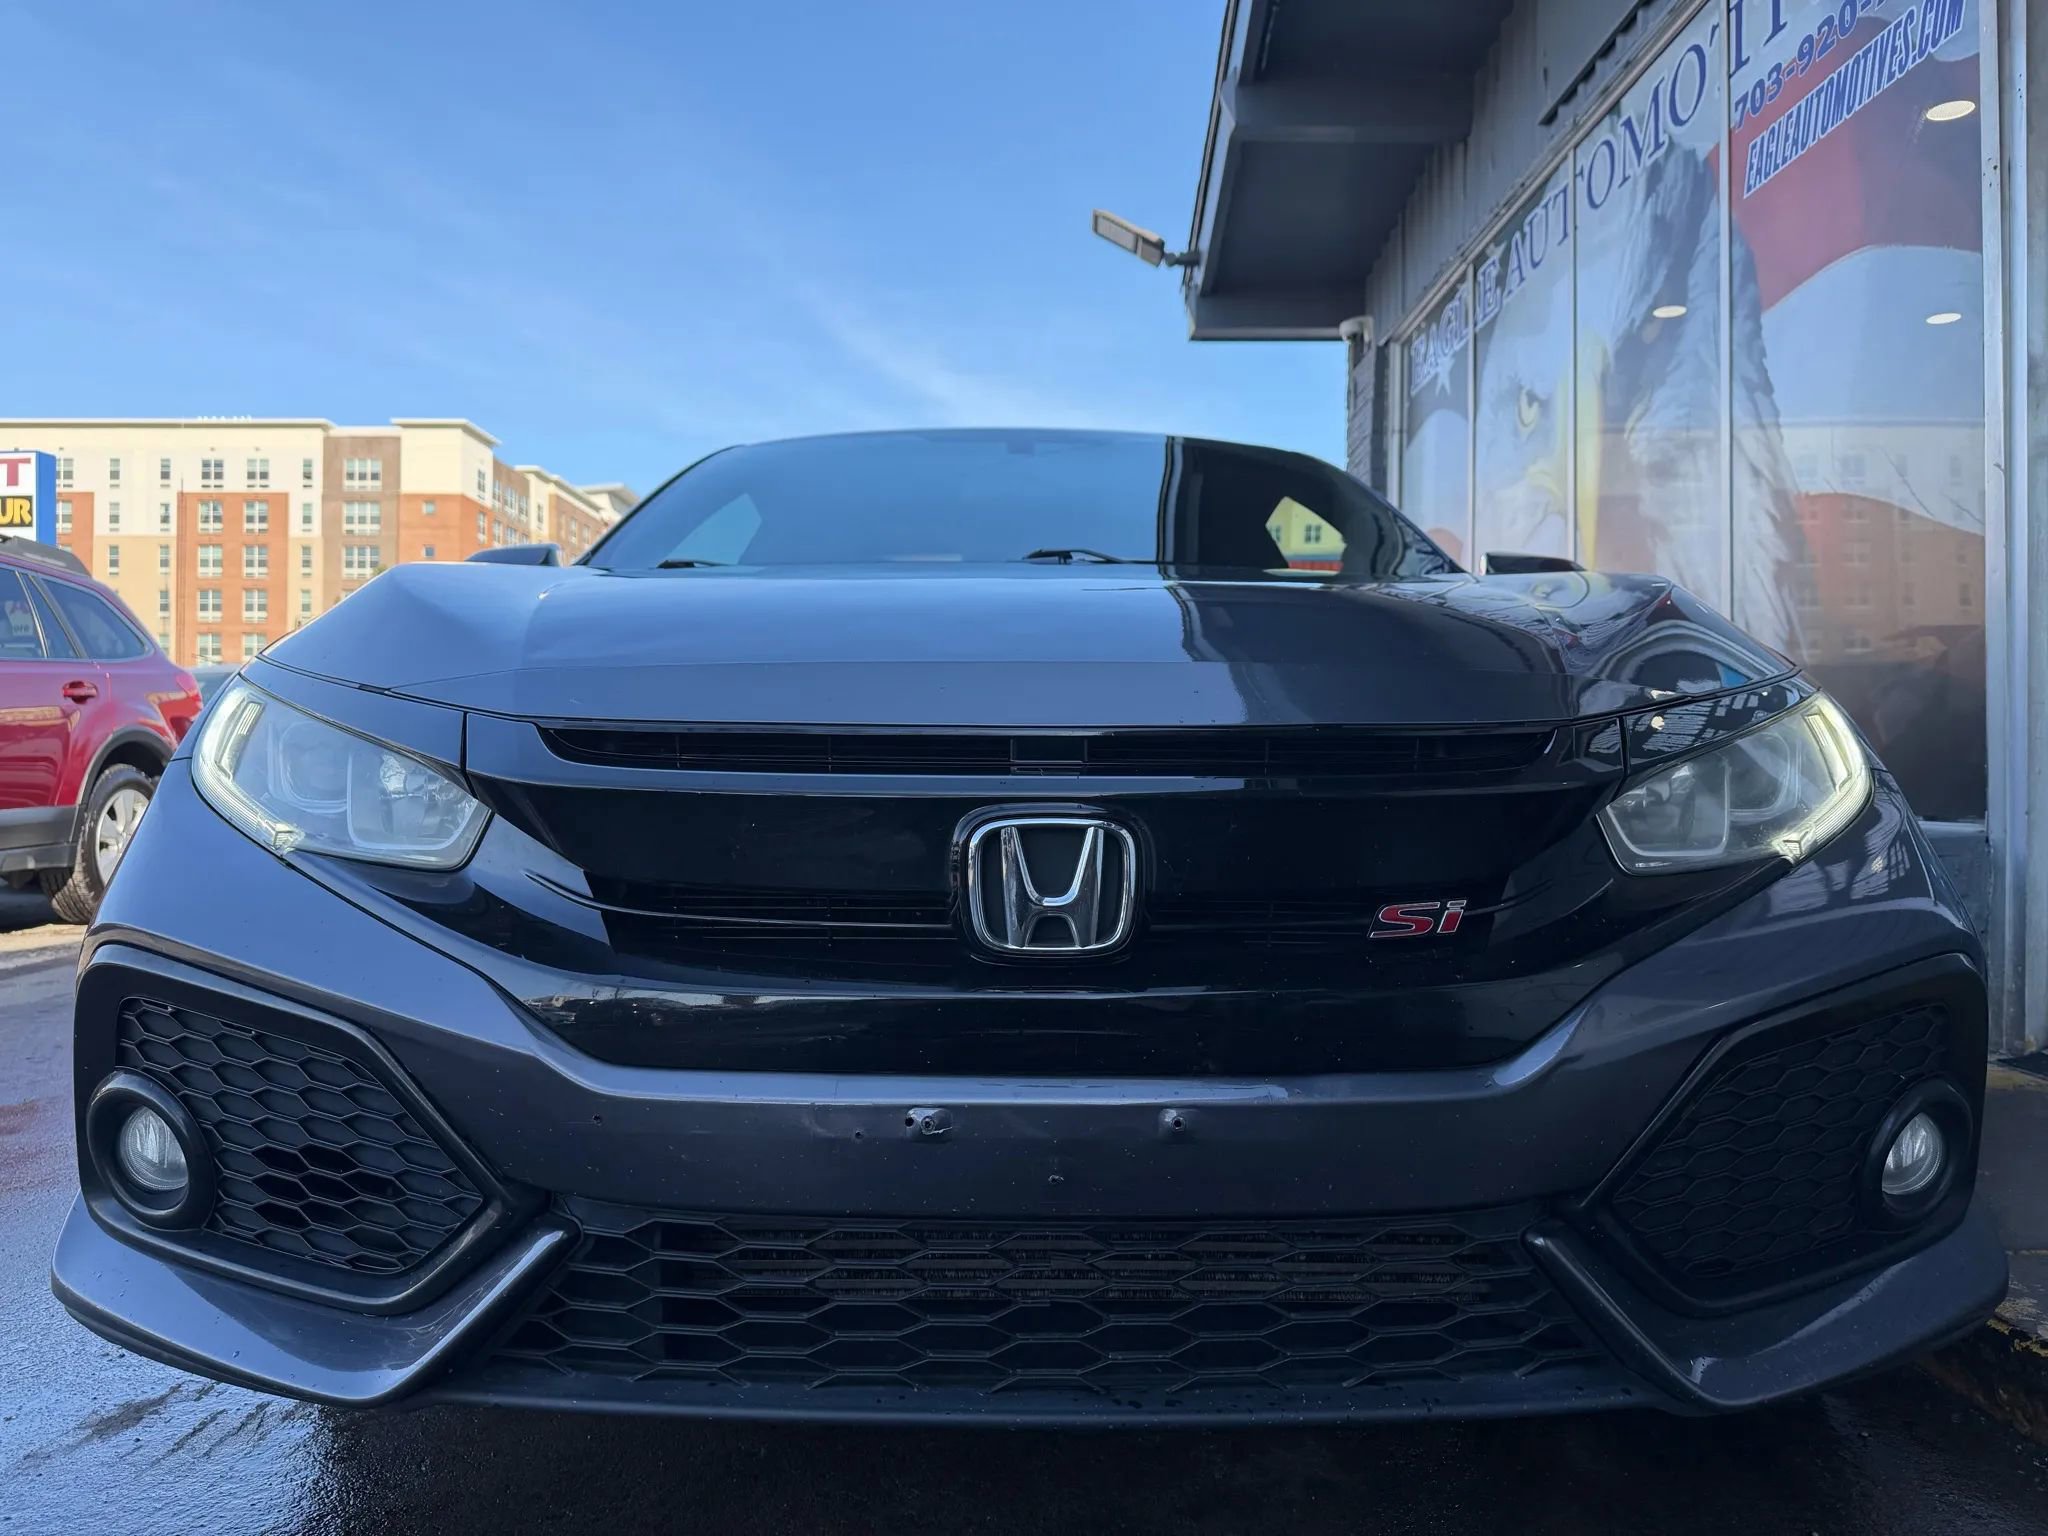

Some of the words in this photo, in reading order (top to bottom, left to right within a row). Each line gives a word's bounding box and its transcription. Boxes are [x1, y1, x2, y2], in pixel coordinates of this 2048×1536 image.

[1734, 0, 1887, 132] 703-920-
[1411, 258, 1503, 393] EAGLE
[1368, 899, 1467, 939] Si
